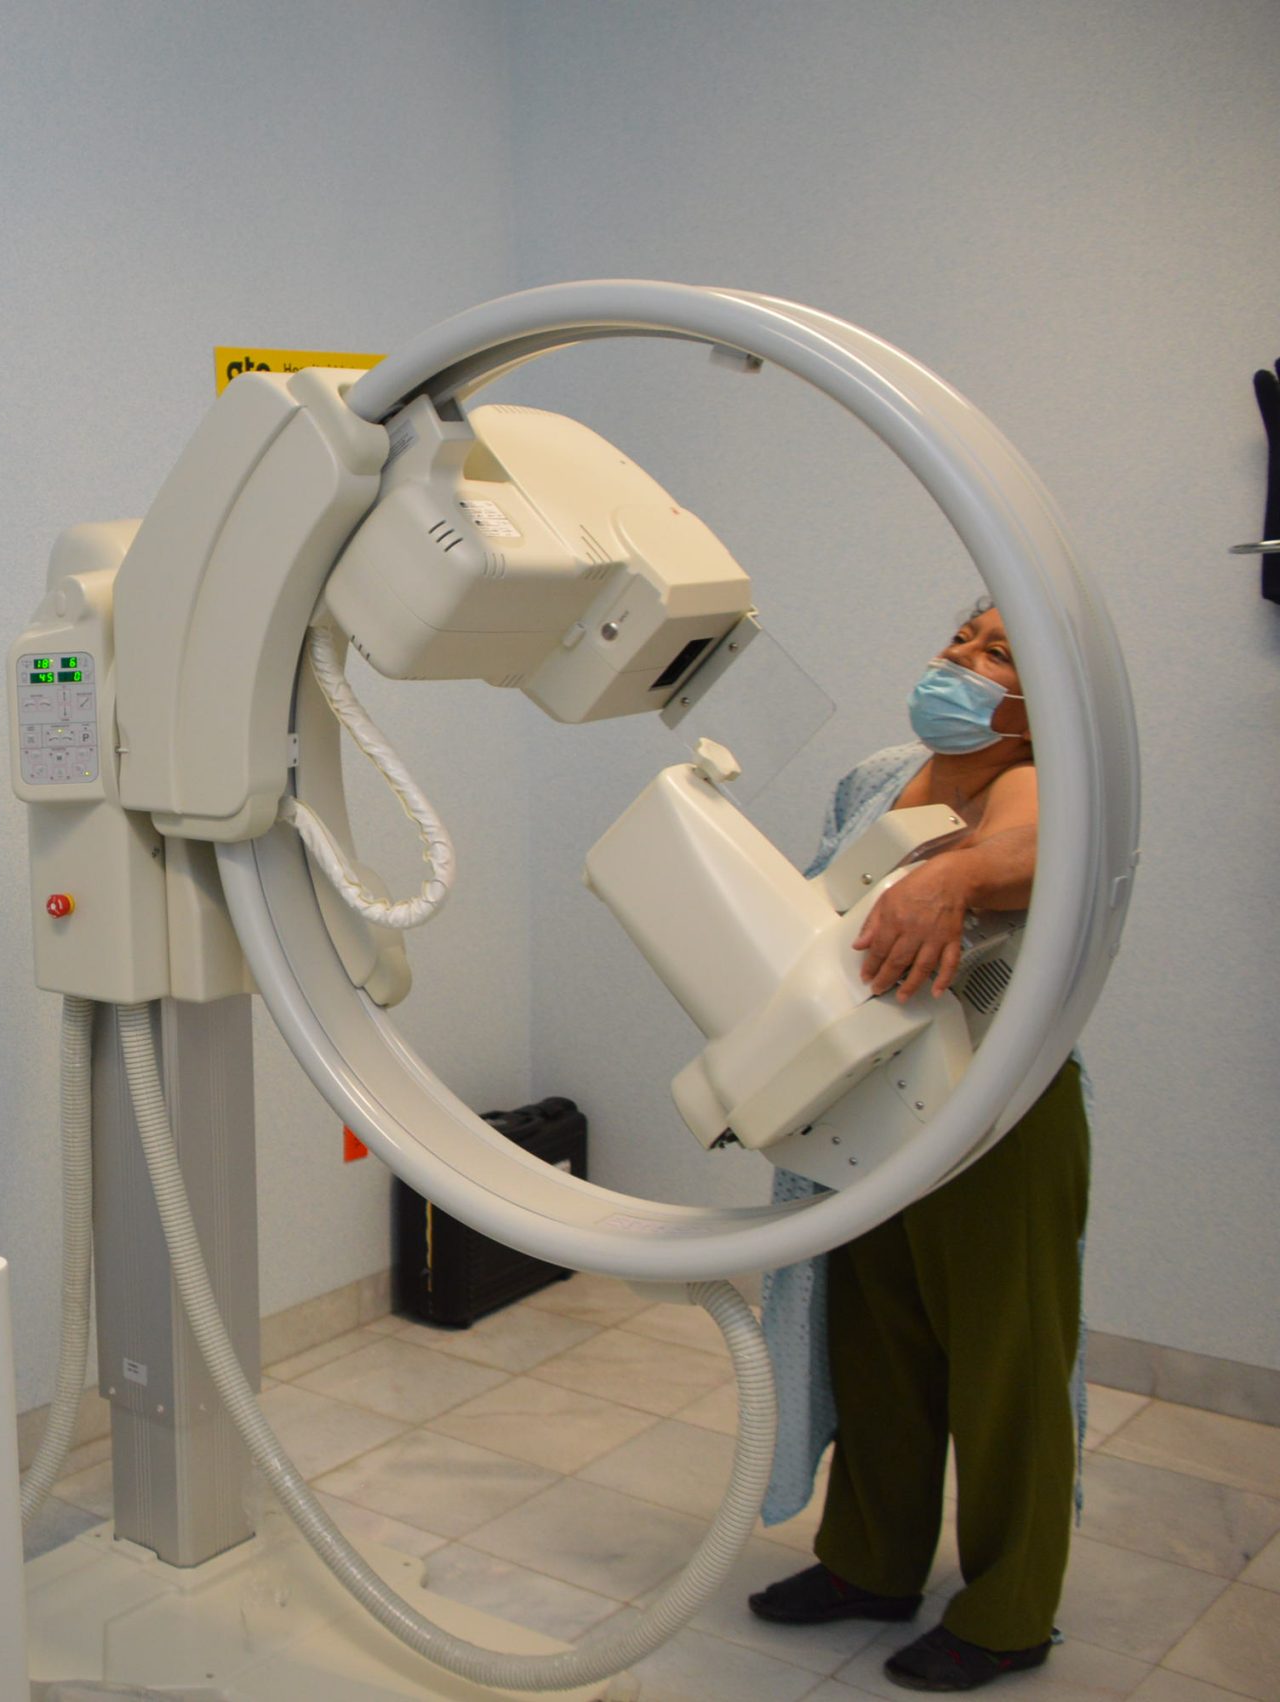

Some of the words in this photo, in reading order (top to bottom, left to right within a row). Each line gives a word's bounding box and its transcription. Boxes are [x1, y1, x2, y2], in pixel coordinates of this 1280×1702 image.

[36, 658, 50, 669] 18
[38, 671, 54, 683] 45
[82, 733, 90, 742] P
